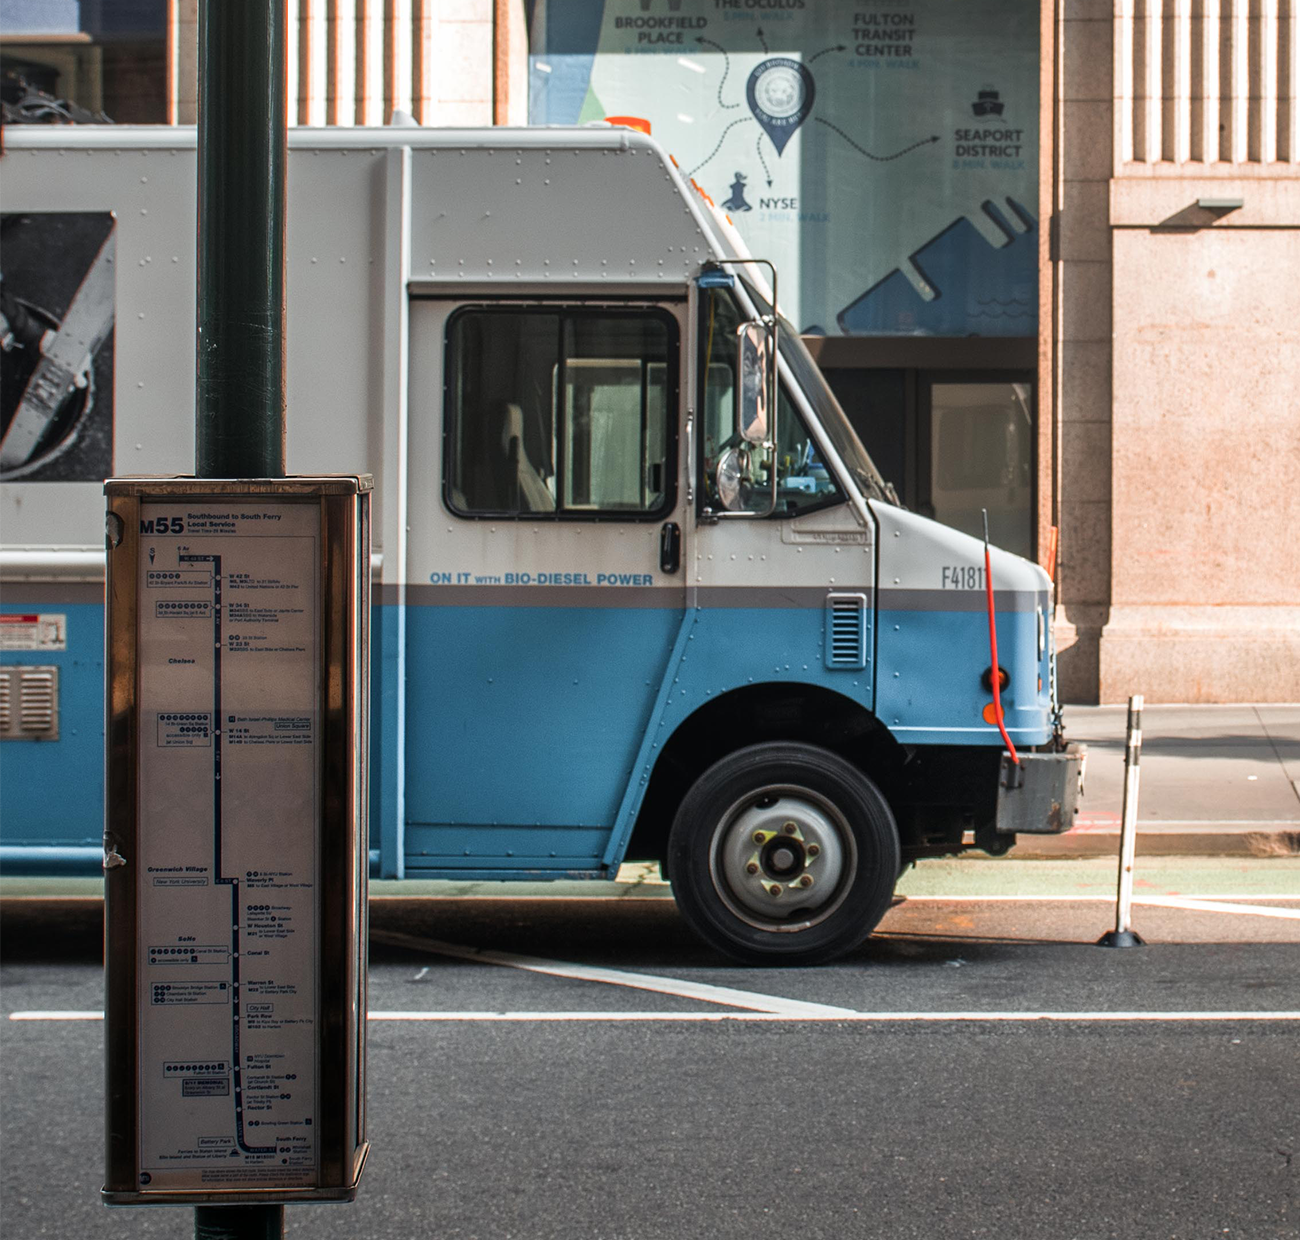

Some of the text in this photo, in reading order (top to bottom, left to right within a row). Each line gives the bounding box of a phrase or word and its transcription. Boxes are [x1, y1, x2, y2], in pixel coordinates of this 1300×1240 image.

[716, 0, 804, 9] THE OCULUS
[615, 17, 708, 29] BROOKFIELD
[854, 14, 914, 26] FULTON
[638, 33, 684, 44] PLACE
[852, 29, 916, 41] TRANSIT
[856, 44, 912, 57] CENTER
[954, 129, 1024, 142] SEAPORT
[955, 144, 1022, 158] DISTRICT
[991, 160, 1024, 170] WALK
[760, 198, 797, 210] NYSE
[140, 517, 184, 534] M55
[430, 572, 654, 587] ON IT WITH BIO-DIESEL POWER
